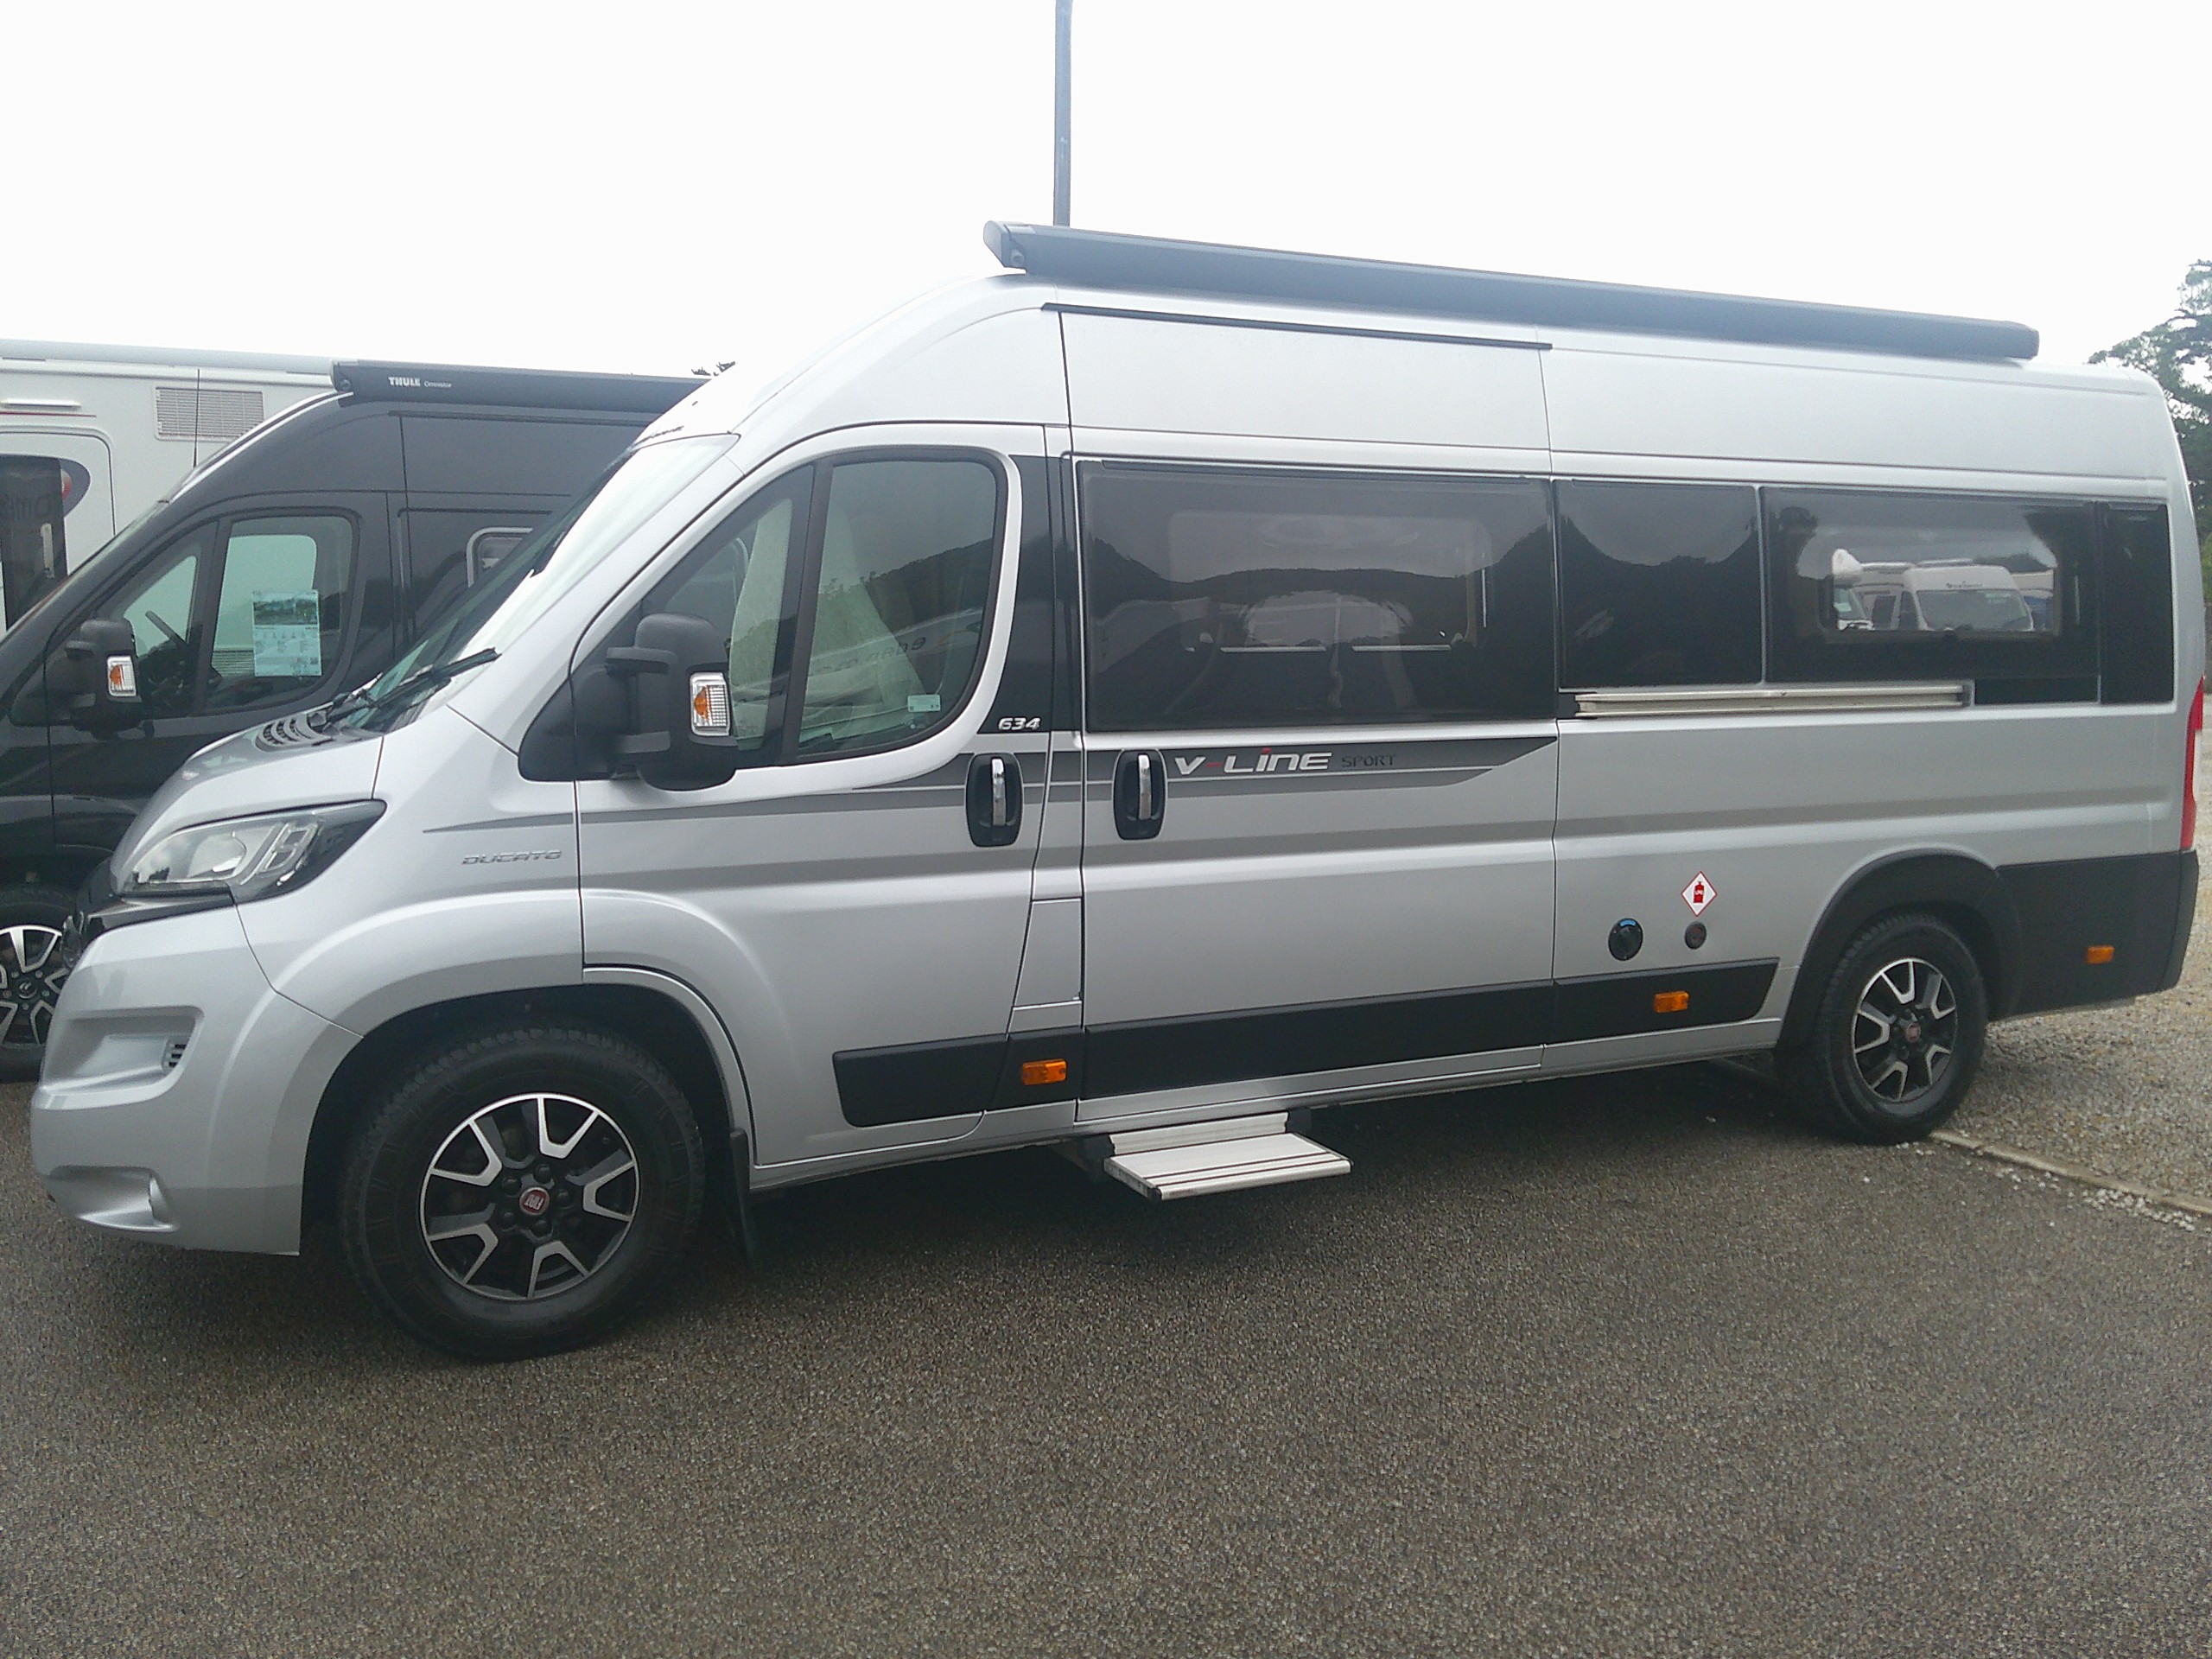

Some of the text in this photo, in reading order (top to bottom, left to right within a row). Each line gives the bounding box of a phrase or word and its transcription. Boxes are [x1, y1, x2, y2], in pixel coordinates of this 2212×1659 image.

[388, 377, 421, 387] THULE
[998, 717, 1041, 731] 634
[1341, 753, 1396, 768] SPORT
[461, 849, 563, 866] DUCATO
